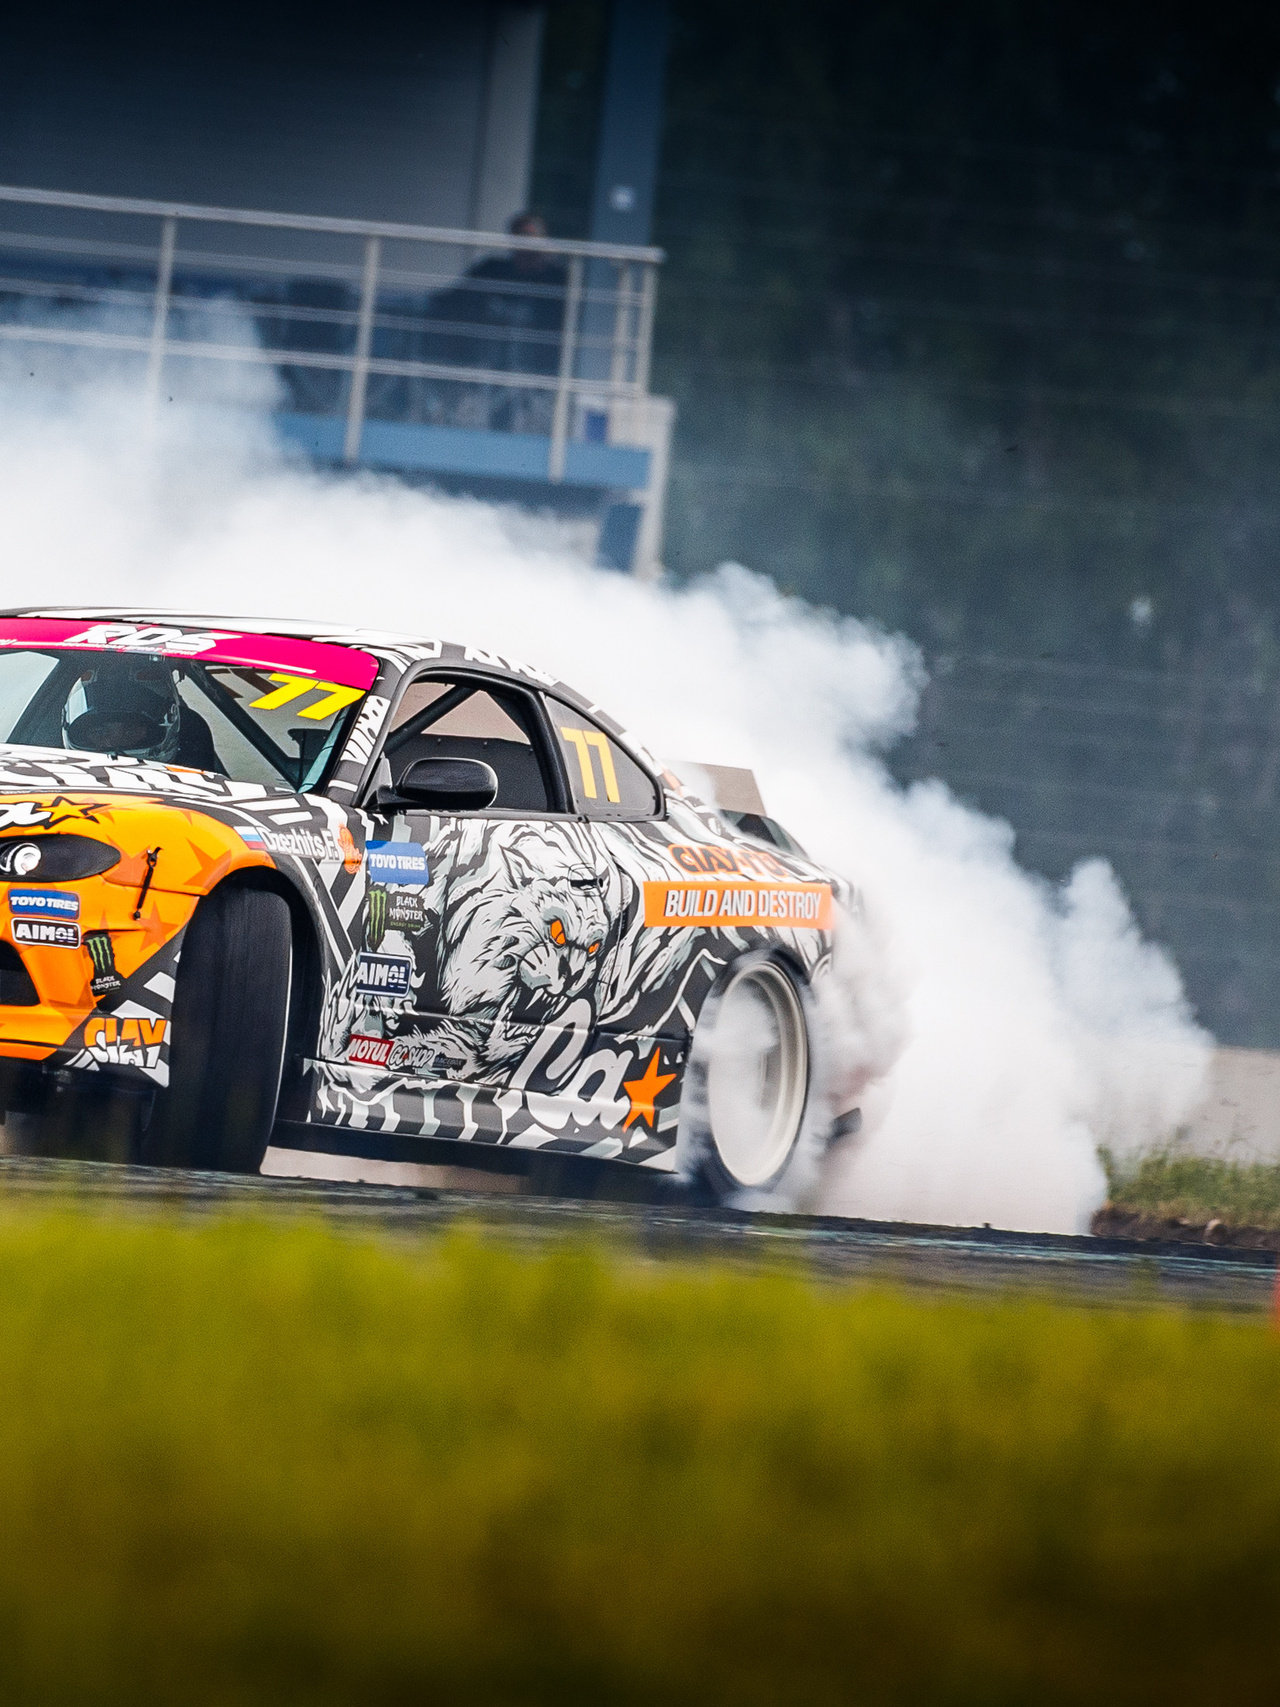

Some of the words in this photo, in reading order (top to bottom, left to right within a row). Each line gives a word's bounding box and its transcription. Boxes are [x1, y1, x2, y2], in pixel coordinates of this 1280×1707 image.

[64, 624, 243, 652] RDS
[249, 673, 366, 720] 77
[560, 727, 620, 803] 77
[256, 826, 326, 859] Dzezhits
[321, 829, 339, 860] F.
[370, 853, 396, 869] TOYO
[397, 856, 425, 870] TIRES
[10, 896, 46, 907] TOYO
[46, 898, 79, 911] TIRES
[389, 907, 424, 922] MONSTER
[395, 896, 418, 908] BLACK
[664, 889, 718, 917] BUILD
[719, 890, 755, 917] AND
[758, 890, 822, 919] DESTROY
[16, 923, 78, 943] AIMOL
[357, 962, 408, 988] AIMOL
[349, 1038, 391, 1063] MOTUL
